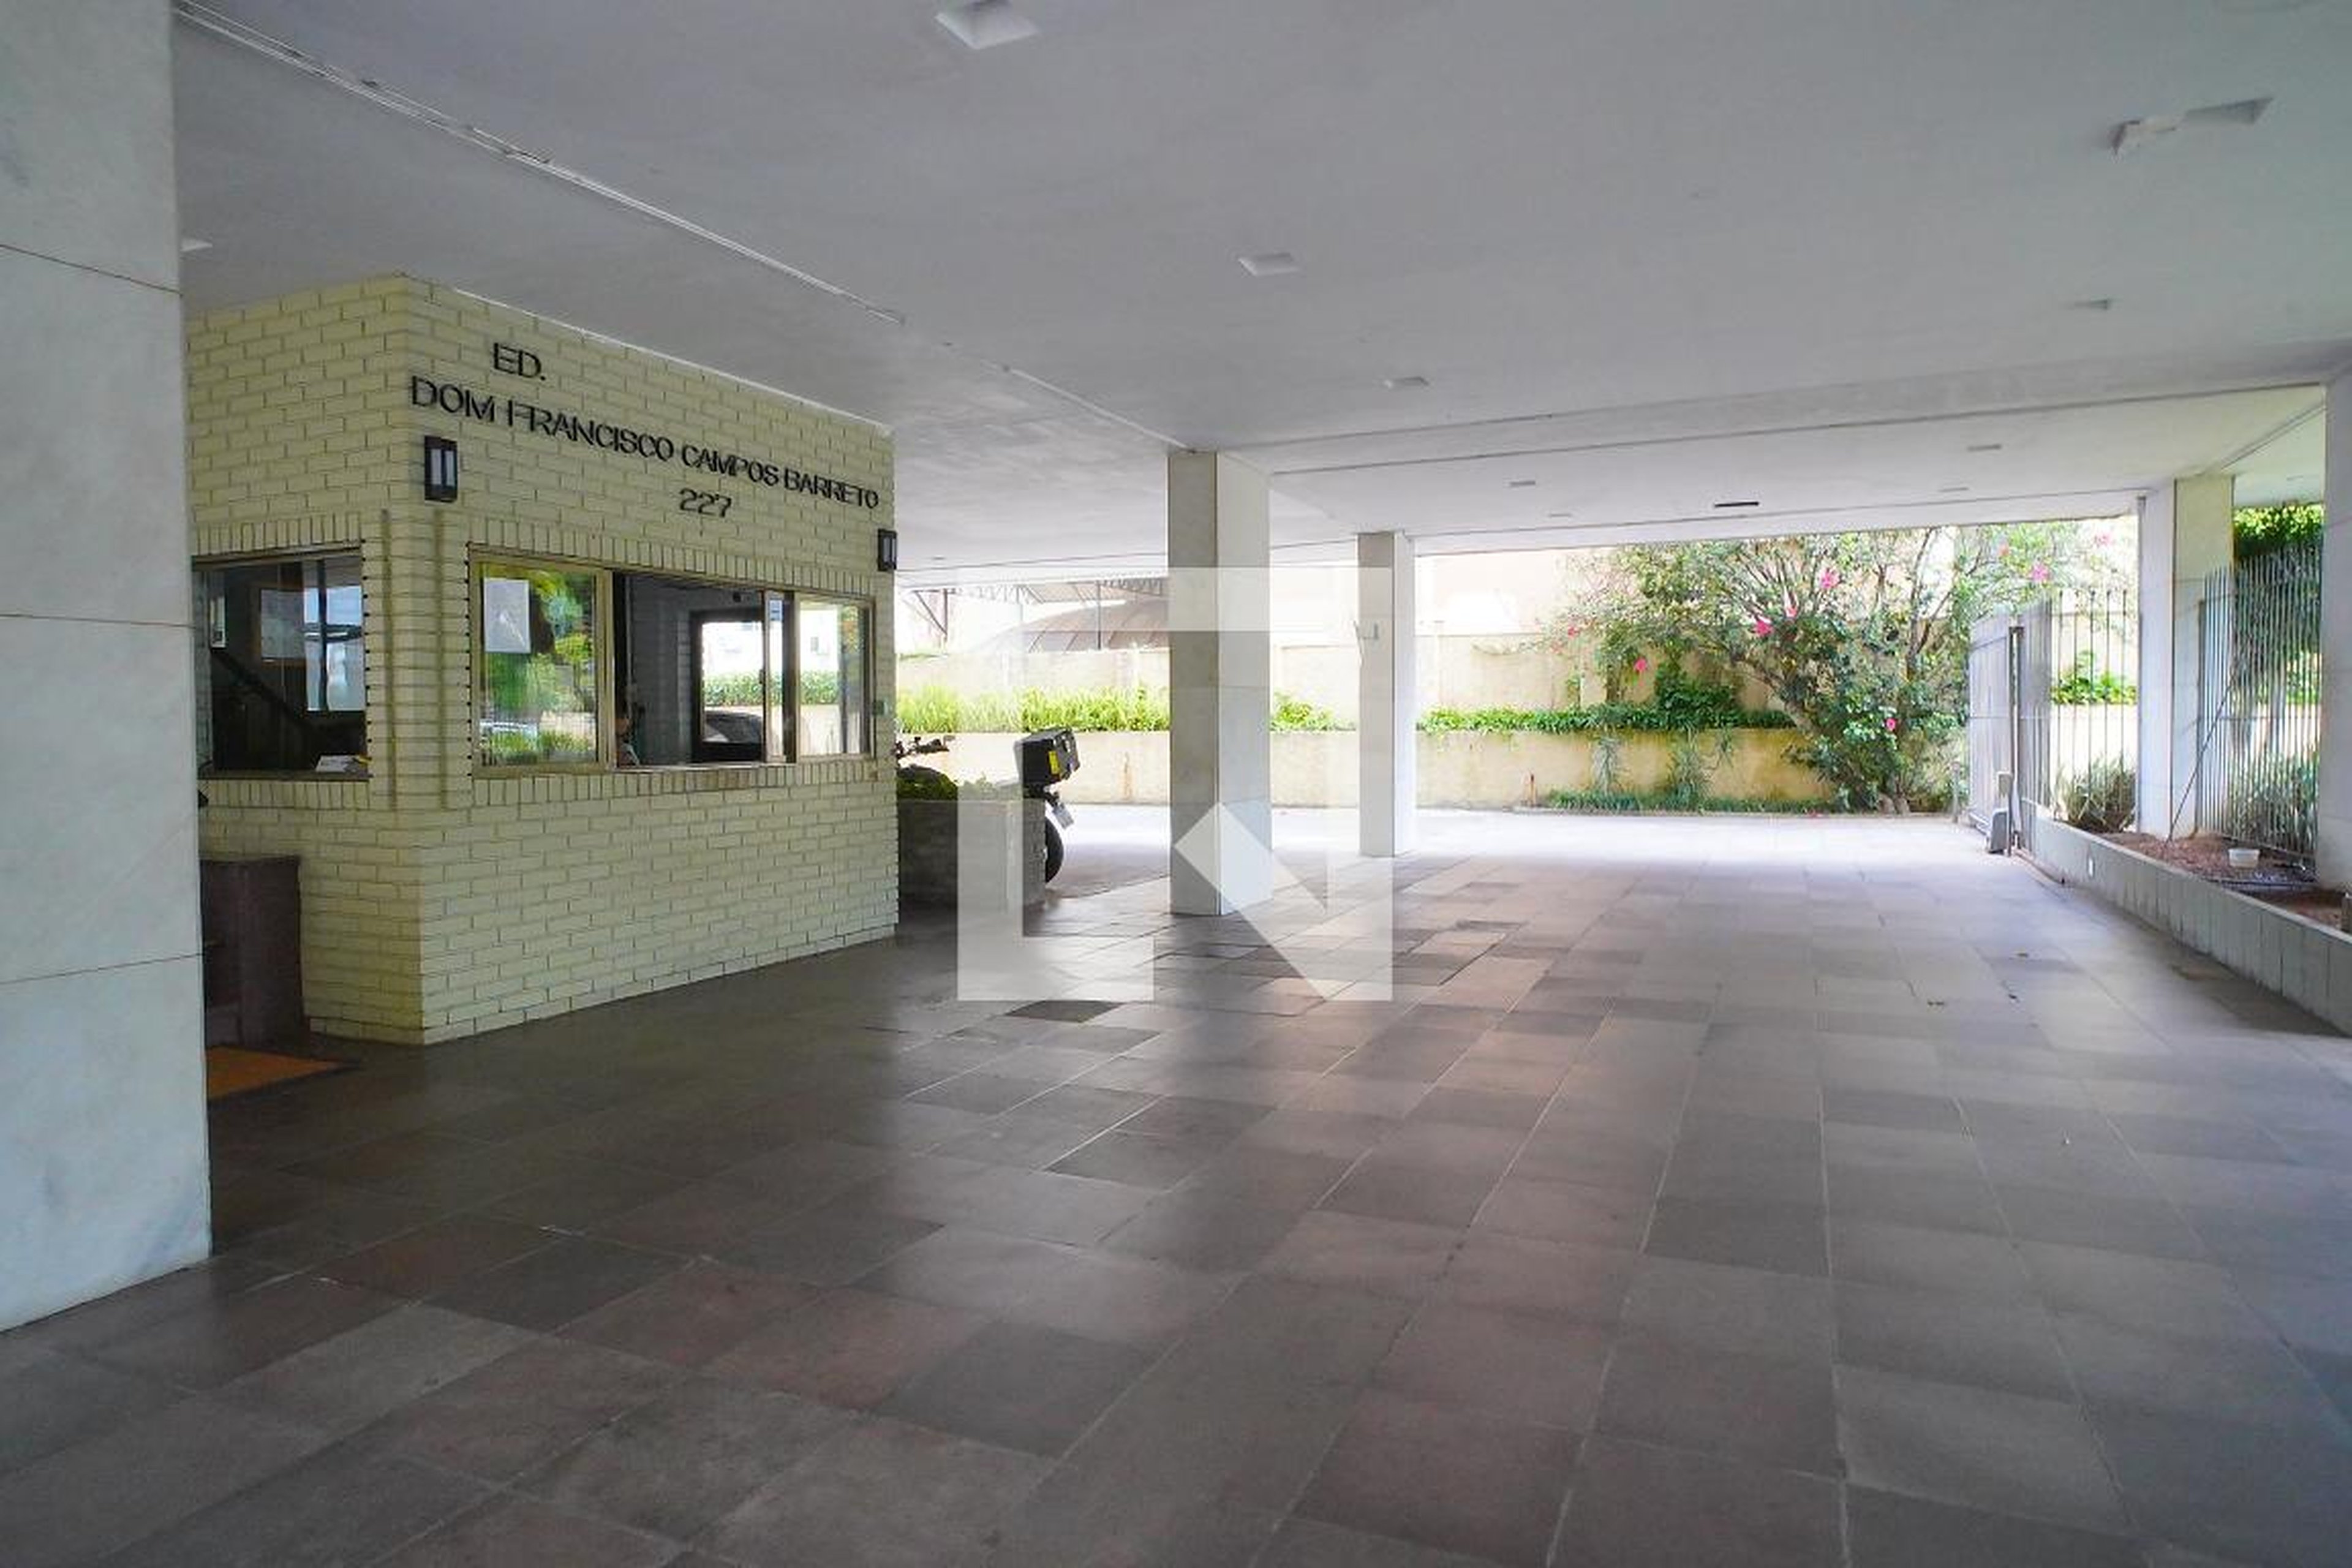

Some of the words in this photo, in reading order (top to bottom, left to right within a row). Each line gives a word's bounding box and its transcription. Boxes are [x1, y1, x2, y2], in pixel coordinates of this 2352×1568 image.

[493, 342, 545, 380] ED.
[412, 376, 495, 423] DOM
[508, 401, 674, 461] FRANCISCO
[682, 445, 779, 486] CAMPOS
[784, 468, 879, 509] BARRETO
[679, 488, 732, 517] 227
